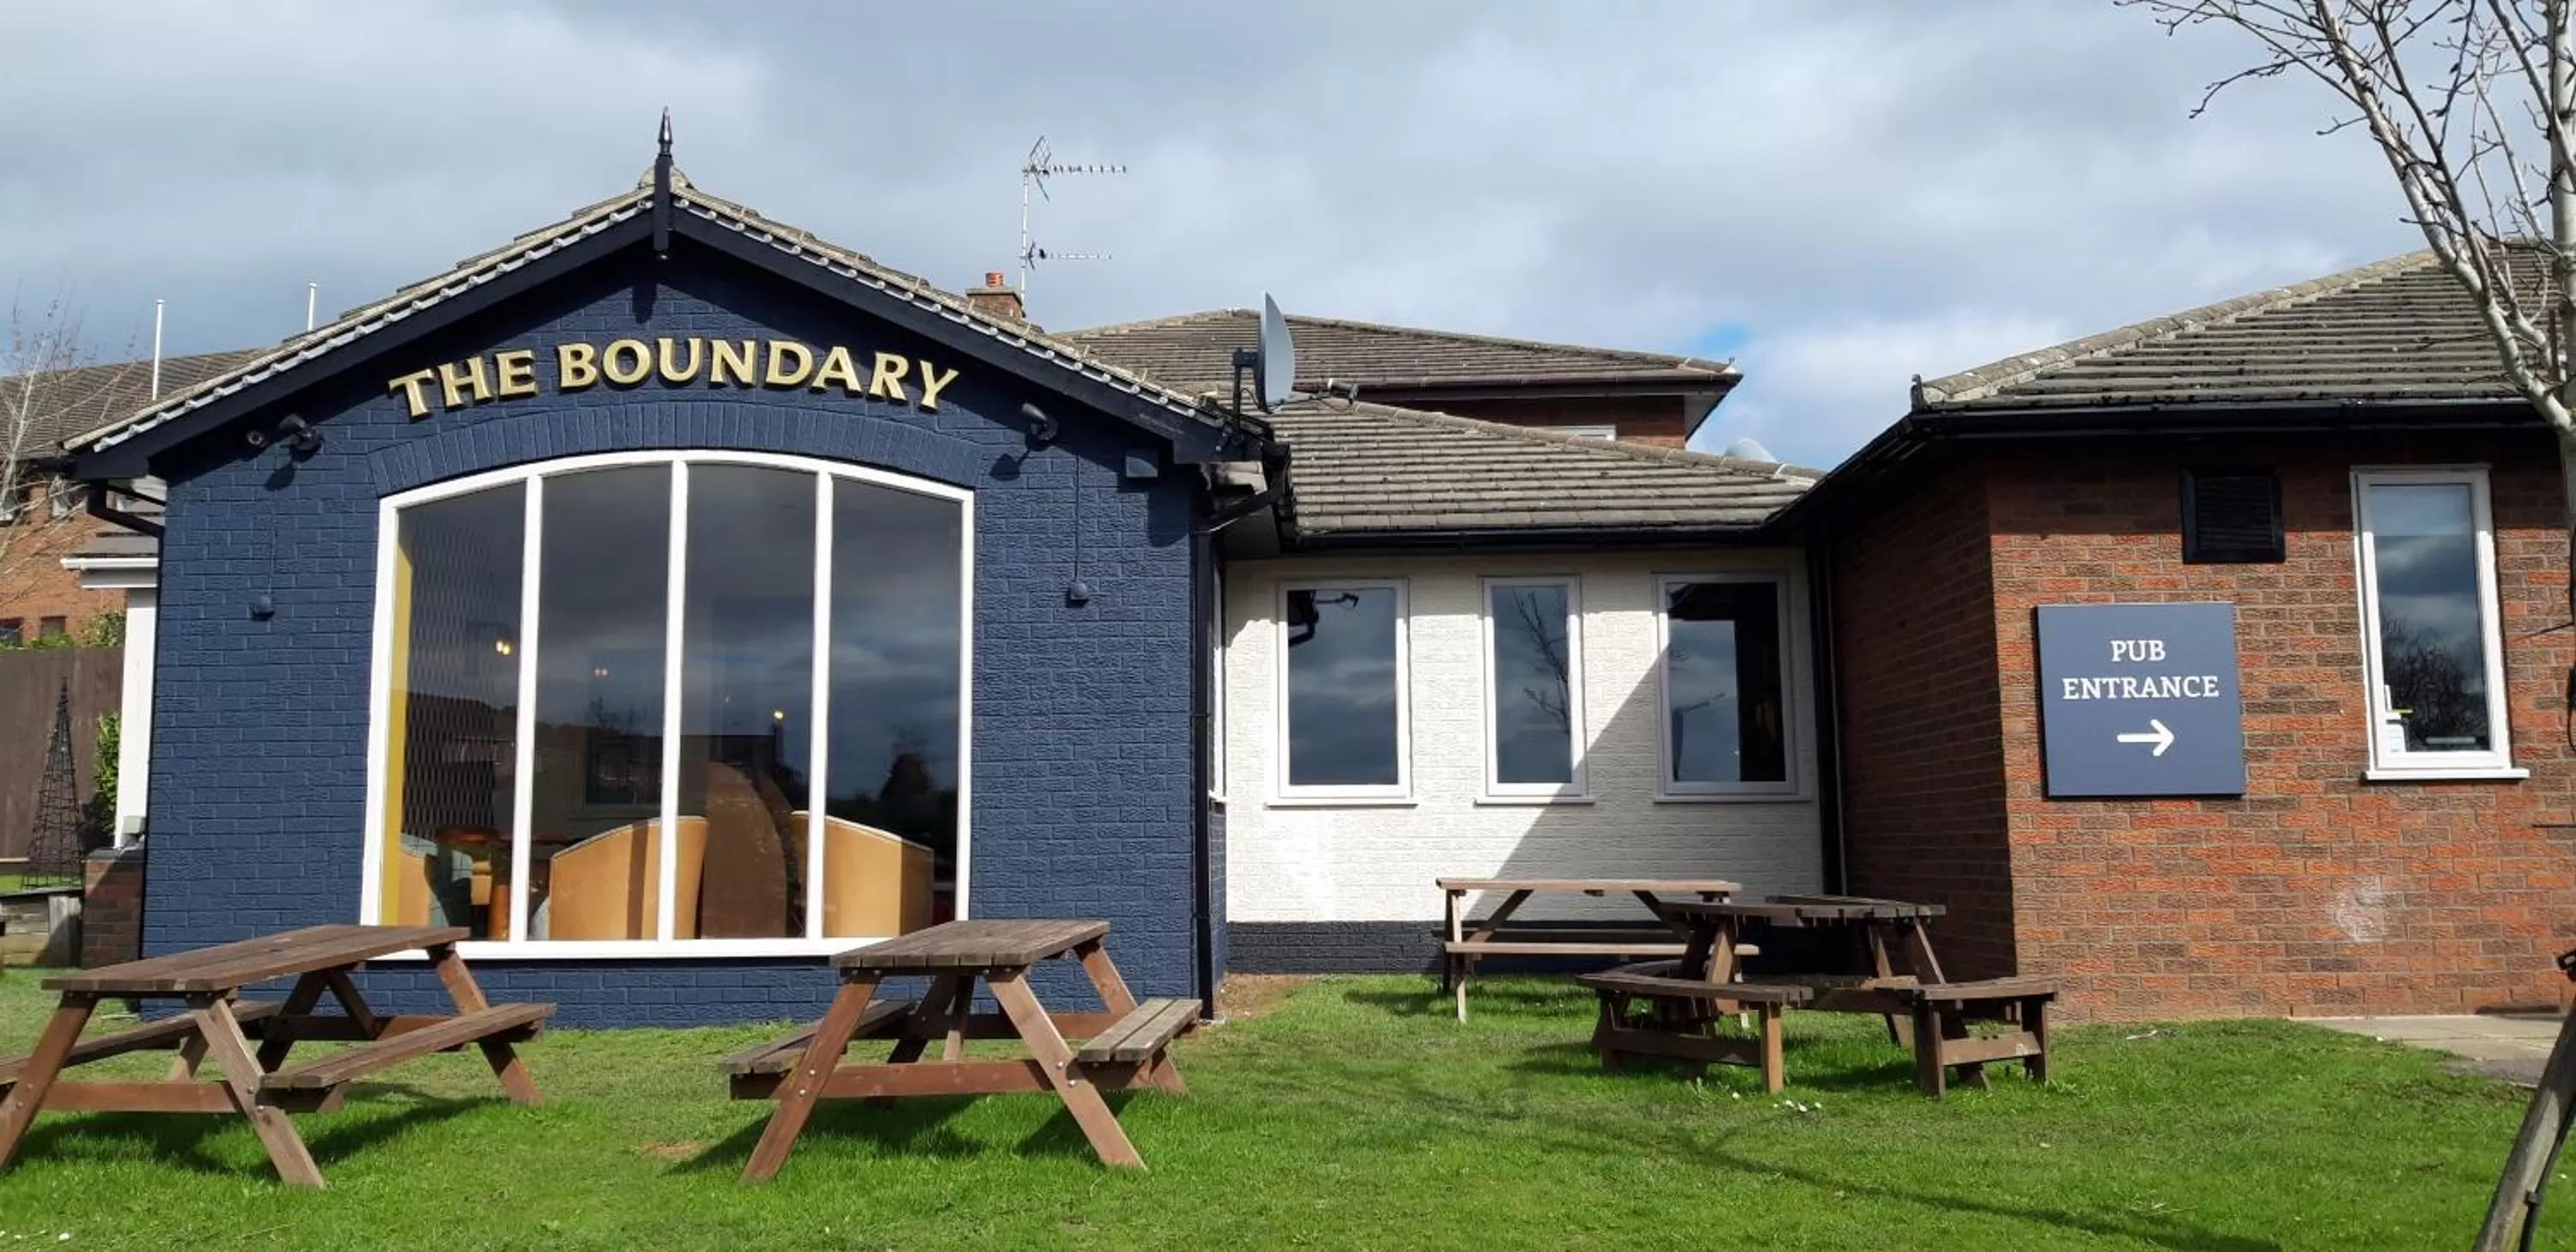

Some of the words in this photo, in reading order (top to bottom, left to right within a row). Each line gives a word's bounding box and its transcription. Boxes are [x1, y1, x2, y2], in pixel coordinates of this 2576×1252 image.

[388, 349, 538, 417] THE
[558, 337, 959, 410] BOUNDARY
[2110, 640, 2166, 662] PUB
[2062, 676, 2220, 700] ENTRANCE
